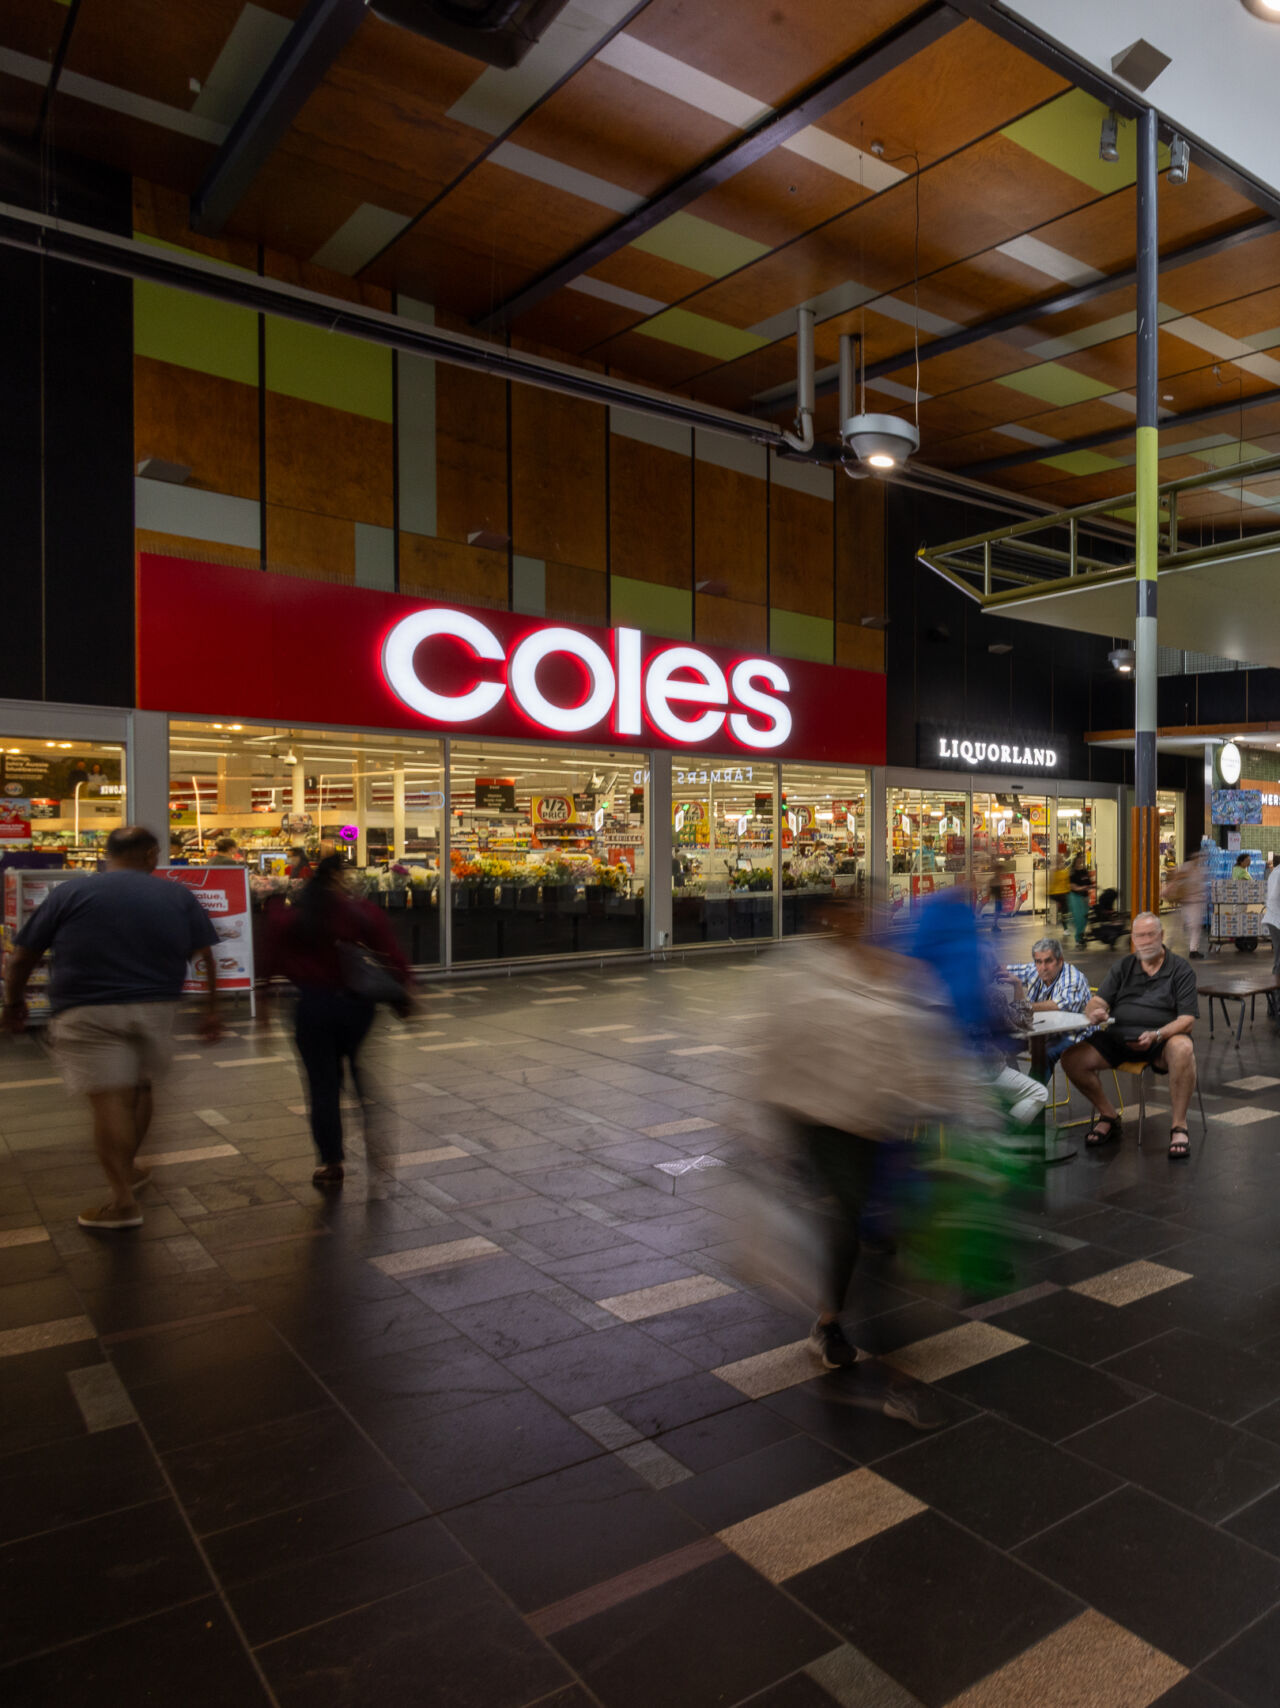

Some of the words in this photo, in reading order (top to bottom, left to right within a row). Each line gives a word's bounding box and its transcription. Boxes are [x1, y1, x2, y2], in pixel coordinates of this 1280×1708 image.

[383, 608, 793, 749] coles
[939, 738, 1057, 767] LIQUORLAND
[542, 799, 565, 810] 1/2
[542, 811, 566, 819] PRICE
[196, 892, 223, 900] alue.
